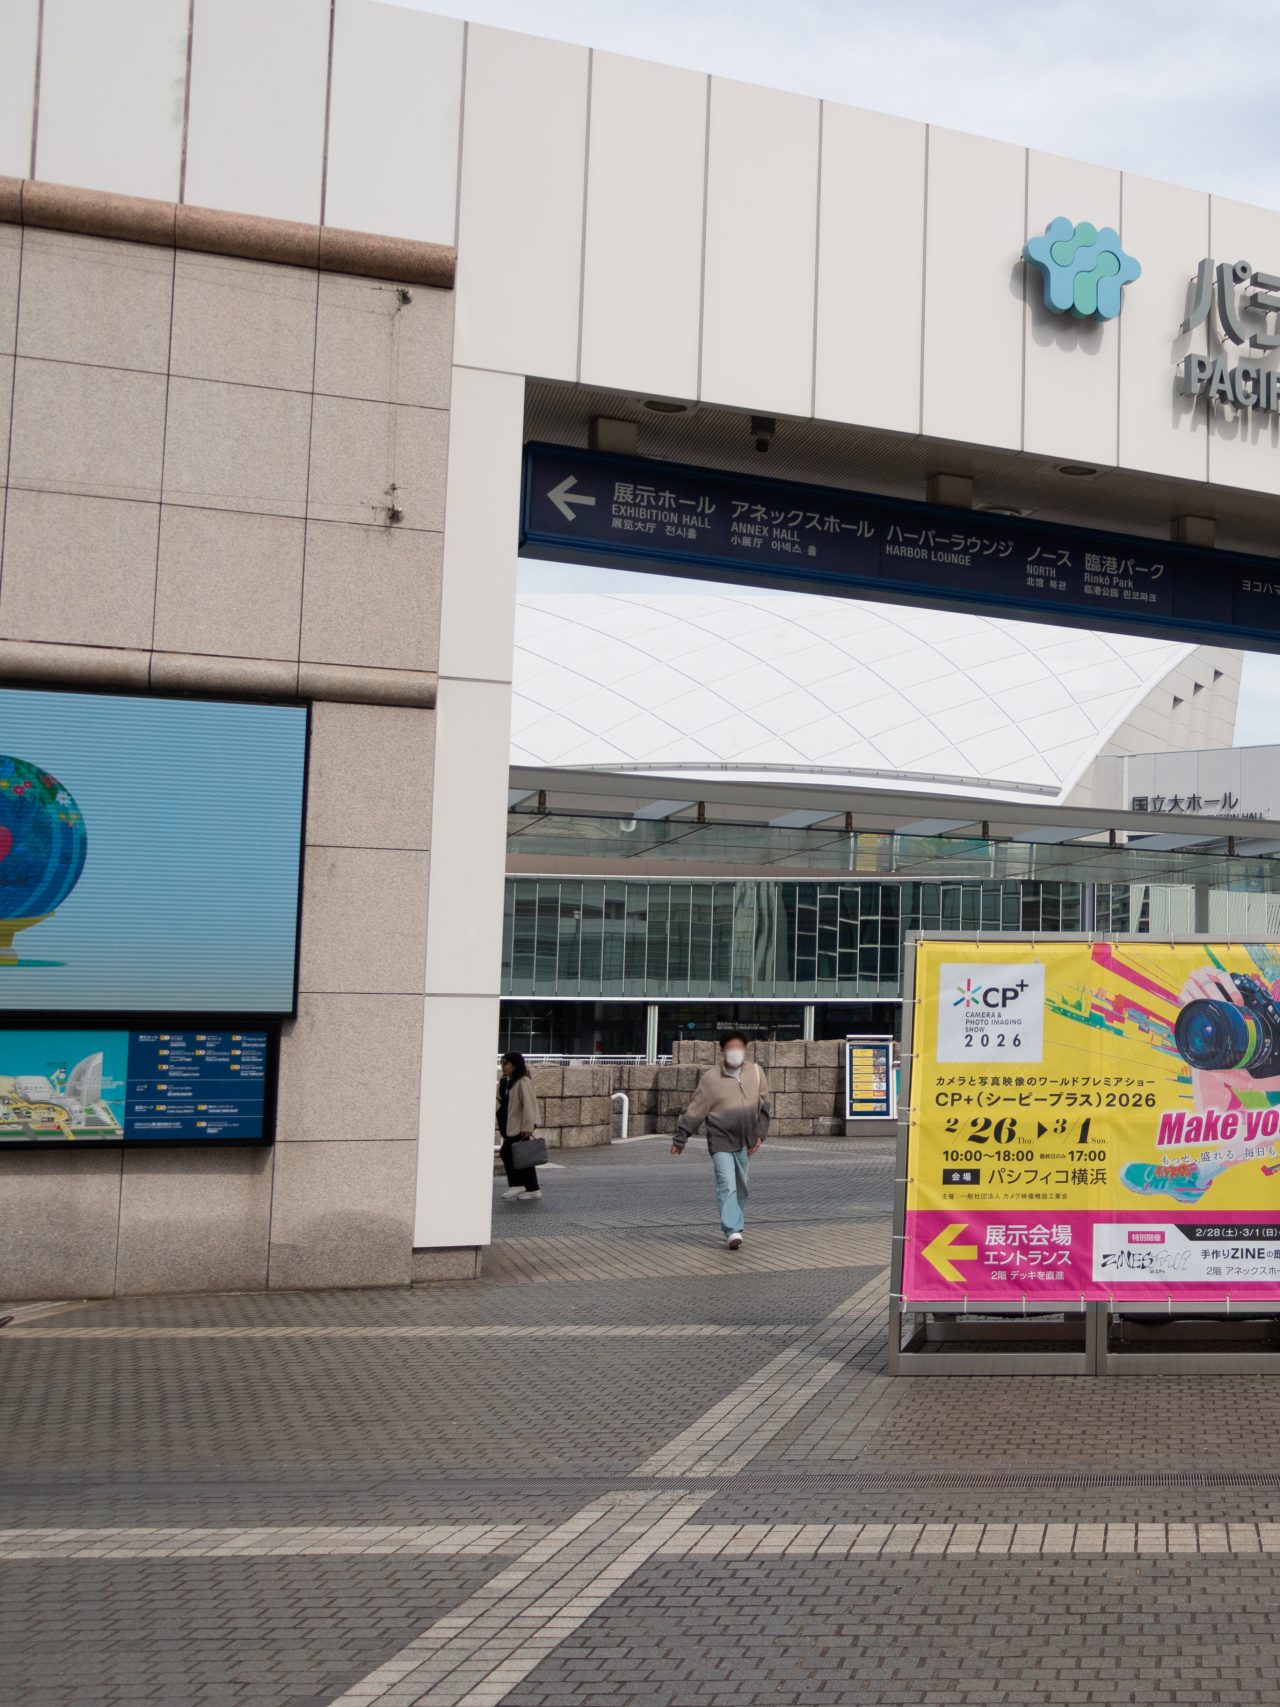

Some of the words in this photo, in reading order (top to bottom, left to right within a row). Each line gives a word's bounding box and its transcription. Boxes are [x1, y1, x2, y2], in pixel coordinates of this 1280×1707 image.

[613, 482, 716, 515] 展示ホール
[611, 517, 657, 533] 展览大厅
[612, 504, 678, 523] EXHIBITION
[682, 514, 712, 529] HALL
[731, 500, 875, 538] アネックスホール
[665, 524, 698, 540] 전시홀
[731, 521, 769, 537] ANNEX
[773, 527, 801, 542] HALL
[731, 535, 763, 549] 小展厅
[886, 525, 1014, 558] ハーバーラウンジ
[886, 544, 928, 561] HARBOR
[931, 550, 972, 566] LOUNGE
[1027, 546, 1072, 567] ノース
[1027, 564, 1056, 578] NORTH
[1085, 553, 1164, 580] 臨港パーク
[1113, 576, 1134, 588] Park
[1132, 791, 1239, 813] 国立大ホール
[982, 979, 1029, 1008] CP+
[991, 1018, 1022, 1026] IMAGING
[964, 1034, 1021, 1048] 2026
[936, 1076, 1156, 1087] カメラと写真映像のワールドプレミアショー
[1157, 1109, 1239, 1145] Make
[1068, 1150, 1106, 1162] 17:00
[951, 1172, 972, 1181] 会場
[988, 1168, 1107, 1185] パシフィコ横浜
[985, 1224, 1073, 1246] 展示会場
[984, 1250, 1072, 1265] エントランス
[991, 1270, 1007, 1280] 2階
[1010, 1270, 1064, 1280] デッキを直進
[1206, 1266, 1222, 1276] 2階
